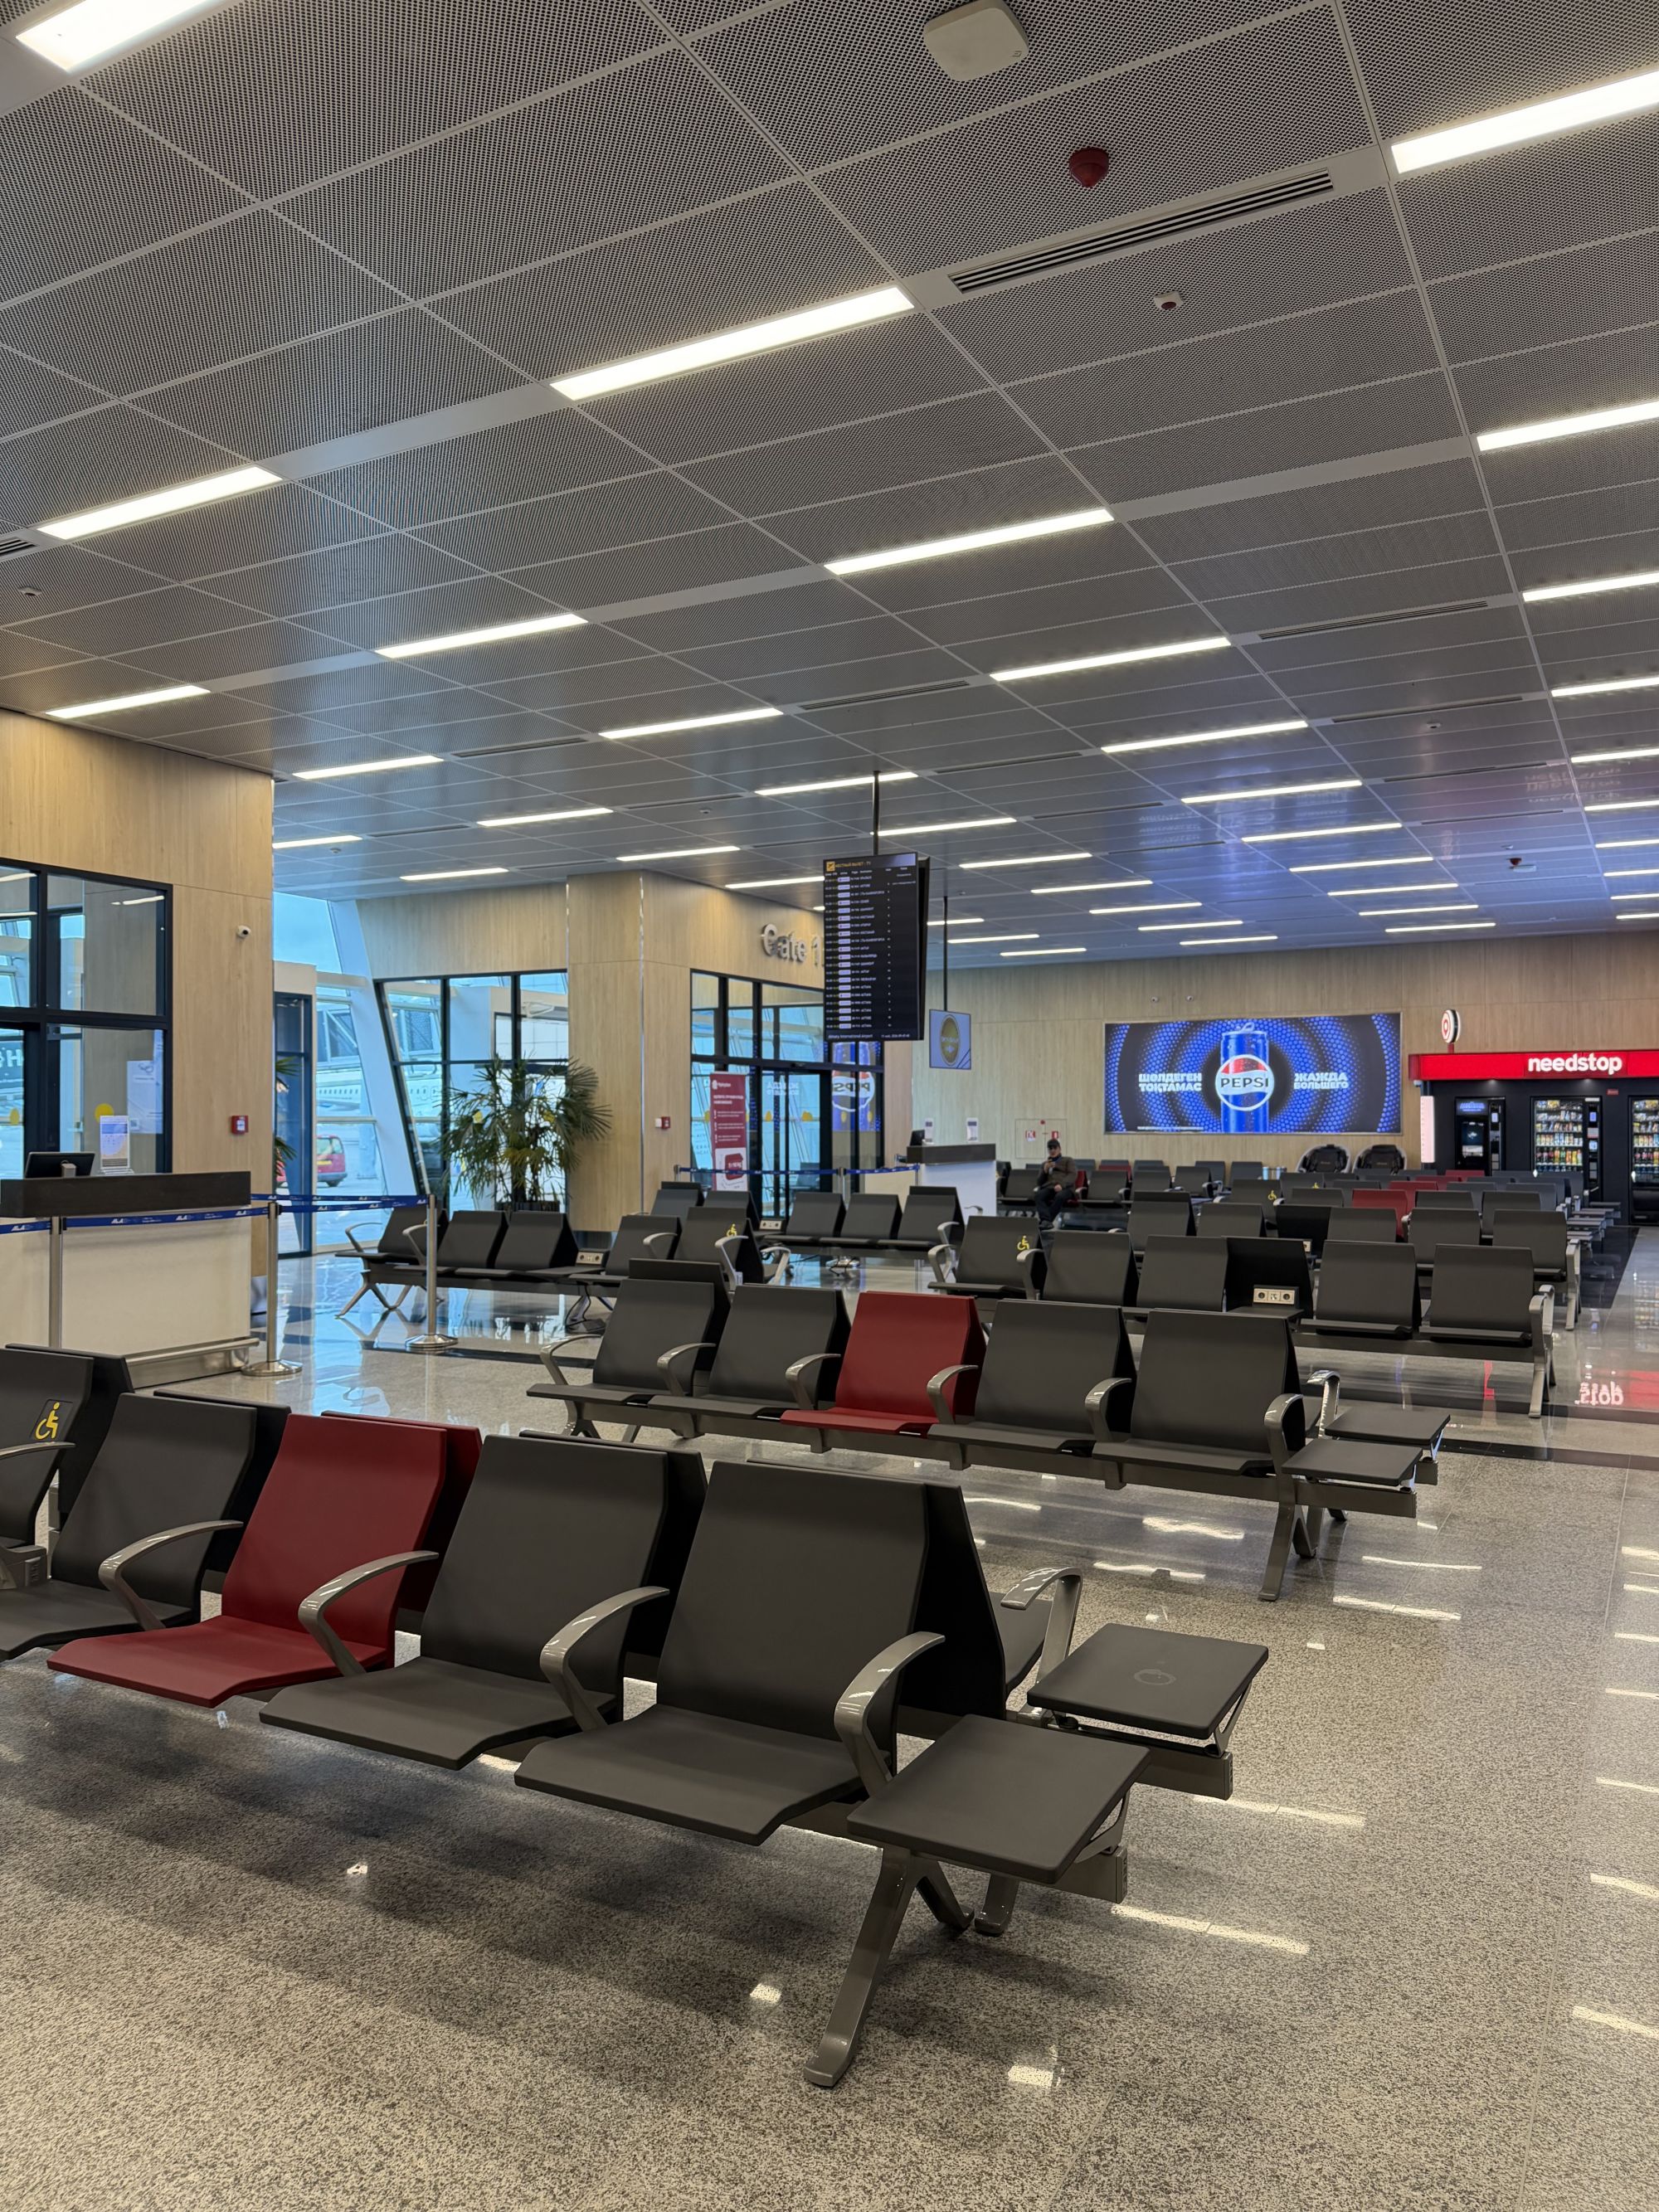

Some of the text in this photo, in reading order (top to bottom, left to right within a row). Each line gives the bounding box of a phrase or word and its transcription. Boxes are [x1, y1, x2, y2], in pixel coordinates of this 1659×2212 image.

[761, 923, 825, 968] Gate 1
[1528, 1053, 1623, 1075] needstop
[1220, 1077, 1269, 1088] PEPSI
[1294, 1072, 1349, 1082] ЖАЖДА
